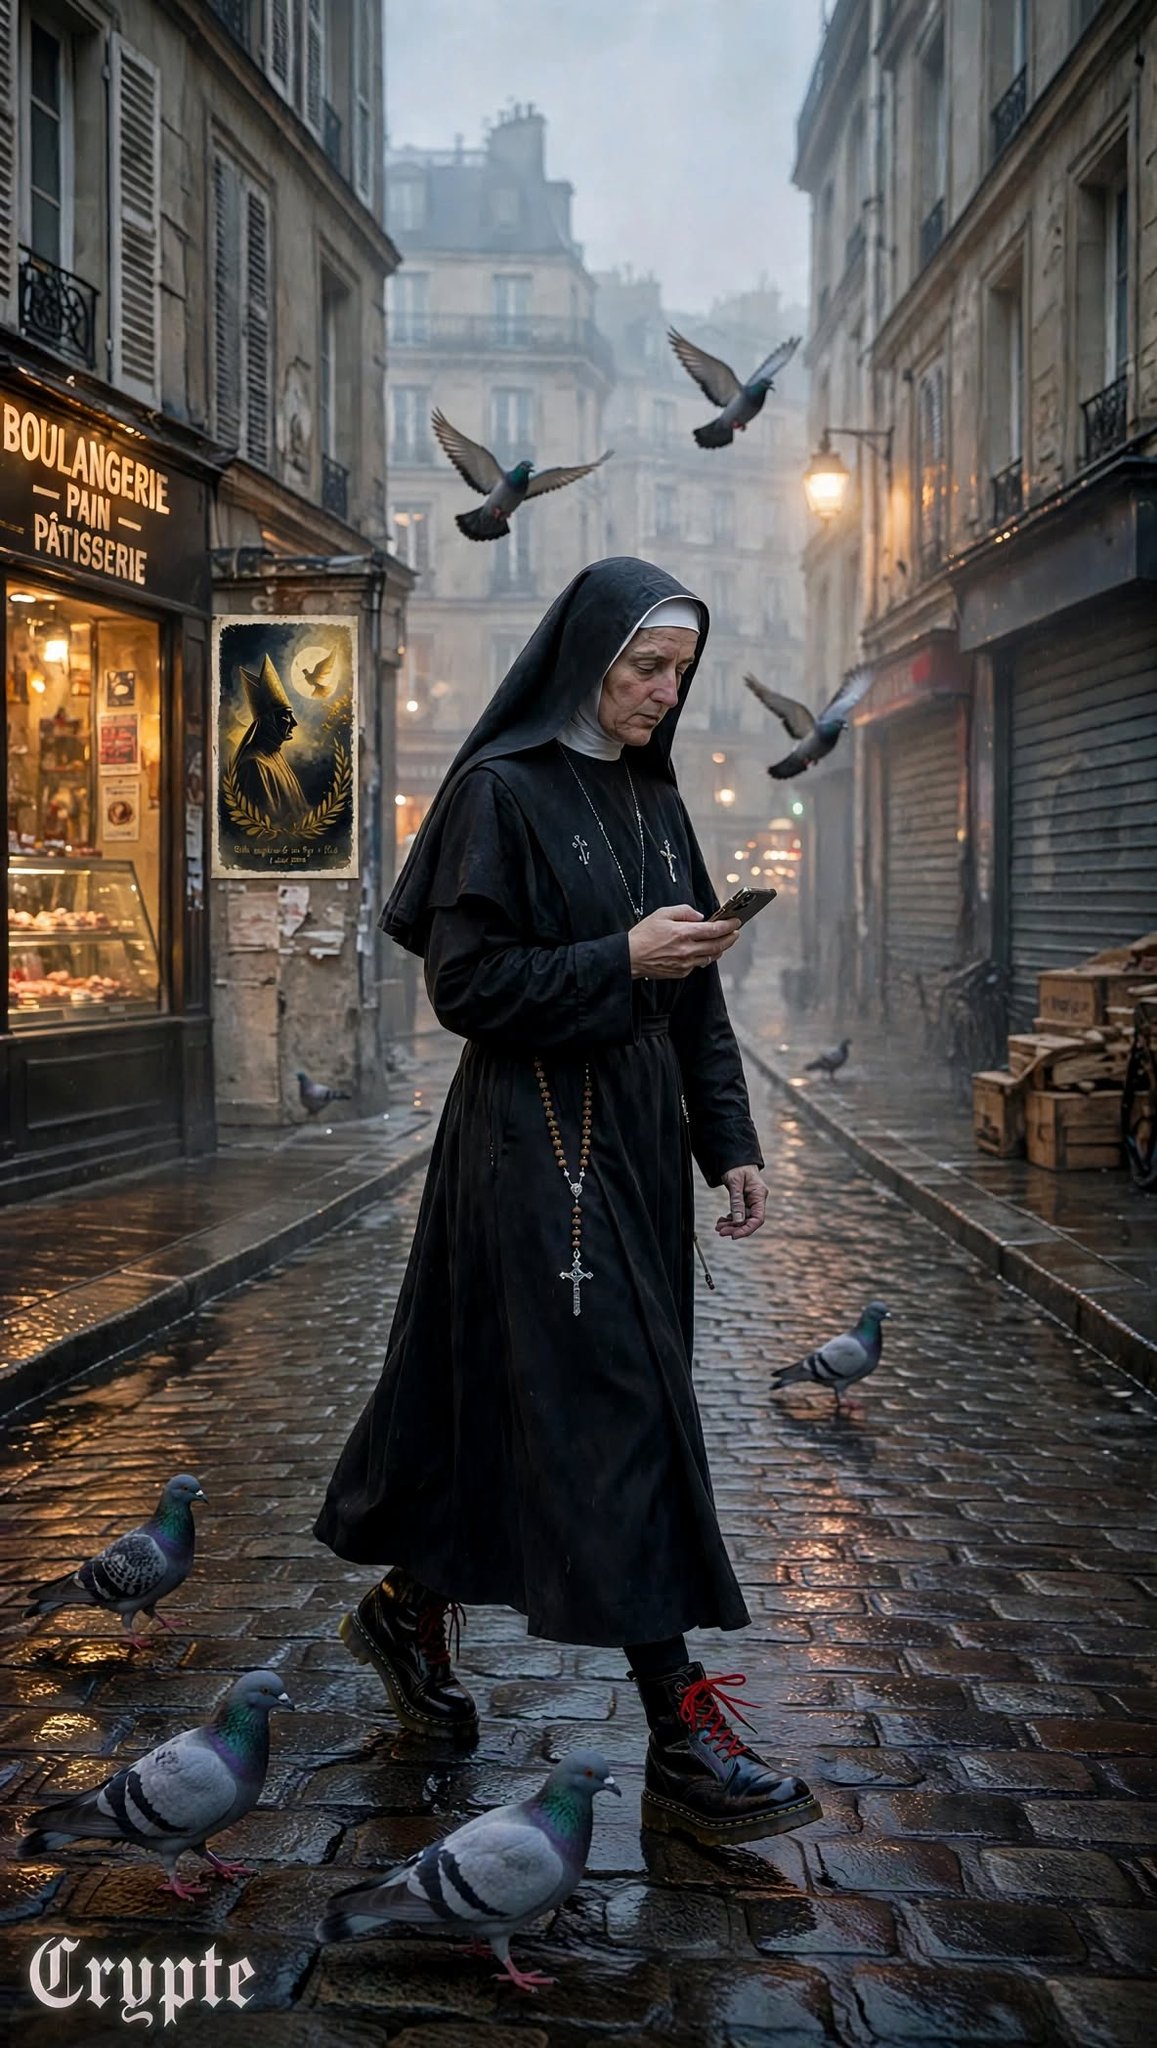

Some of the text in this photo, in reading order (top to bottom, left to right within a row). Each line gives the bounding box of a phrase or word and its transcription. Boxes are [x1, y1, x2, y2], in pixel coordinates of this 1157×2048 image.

[3, 403, 170, 515] BOULANGERIE
[66, 482, 111, 532] PAIN
[34, 511, 147, 586] PÂTISSERIE
